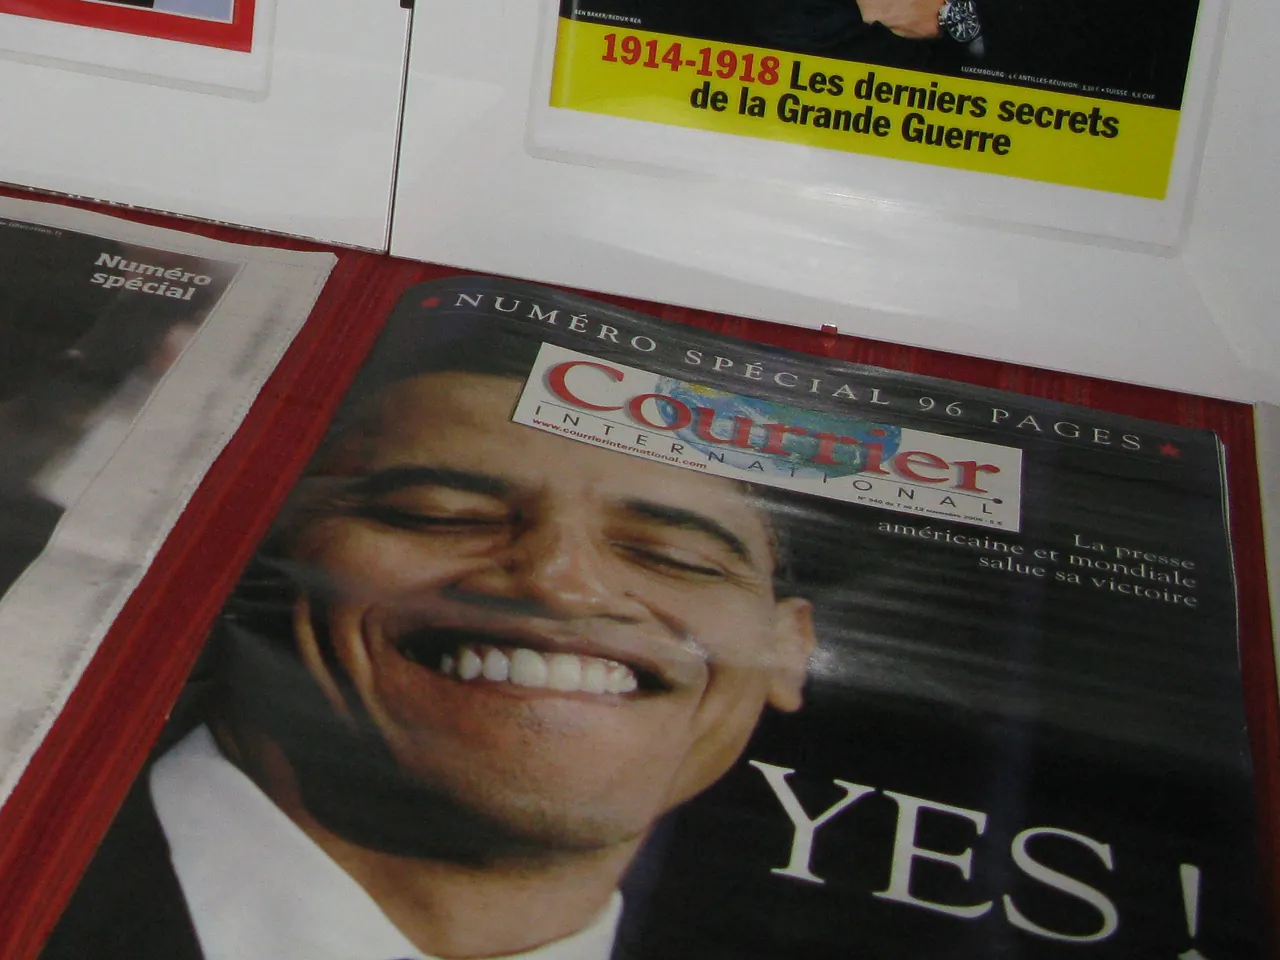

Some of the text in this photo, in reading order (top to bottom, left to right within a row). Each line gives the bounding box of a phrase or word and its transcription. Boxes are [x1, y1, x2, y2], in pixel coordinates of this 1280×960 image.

[601, 32, 1121, 140] 1914-1918 Les derniers secrets
[961, 66, 1005, 78] LUXEMBOURG
[1105, 87, 1128, 97] SUISSE
[689, 81, 1012, 157] de la Grande Guerre
[90, 272, 197, 300] spécial
[94, 252, 213, 286] Numéro
[455, 292, 1143, 452] NUMÉRO SPÉCIAL 96 PAGES
[532, 417, 708, 470] www.courrierinternational.com
[533, 404, 993, 516] INTERNATIONAL
[547, 360, 1002, 495] Courrier
[878, 519, 1197, 588] américaine et mondiale
[978, 554, 1198, 608] salue sa victoire
[1072, 533, 1196, 571] La presse
[748, 759, 1201, 960] YES !
